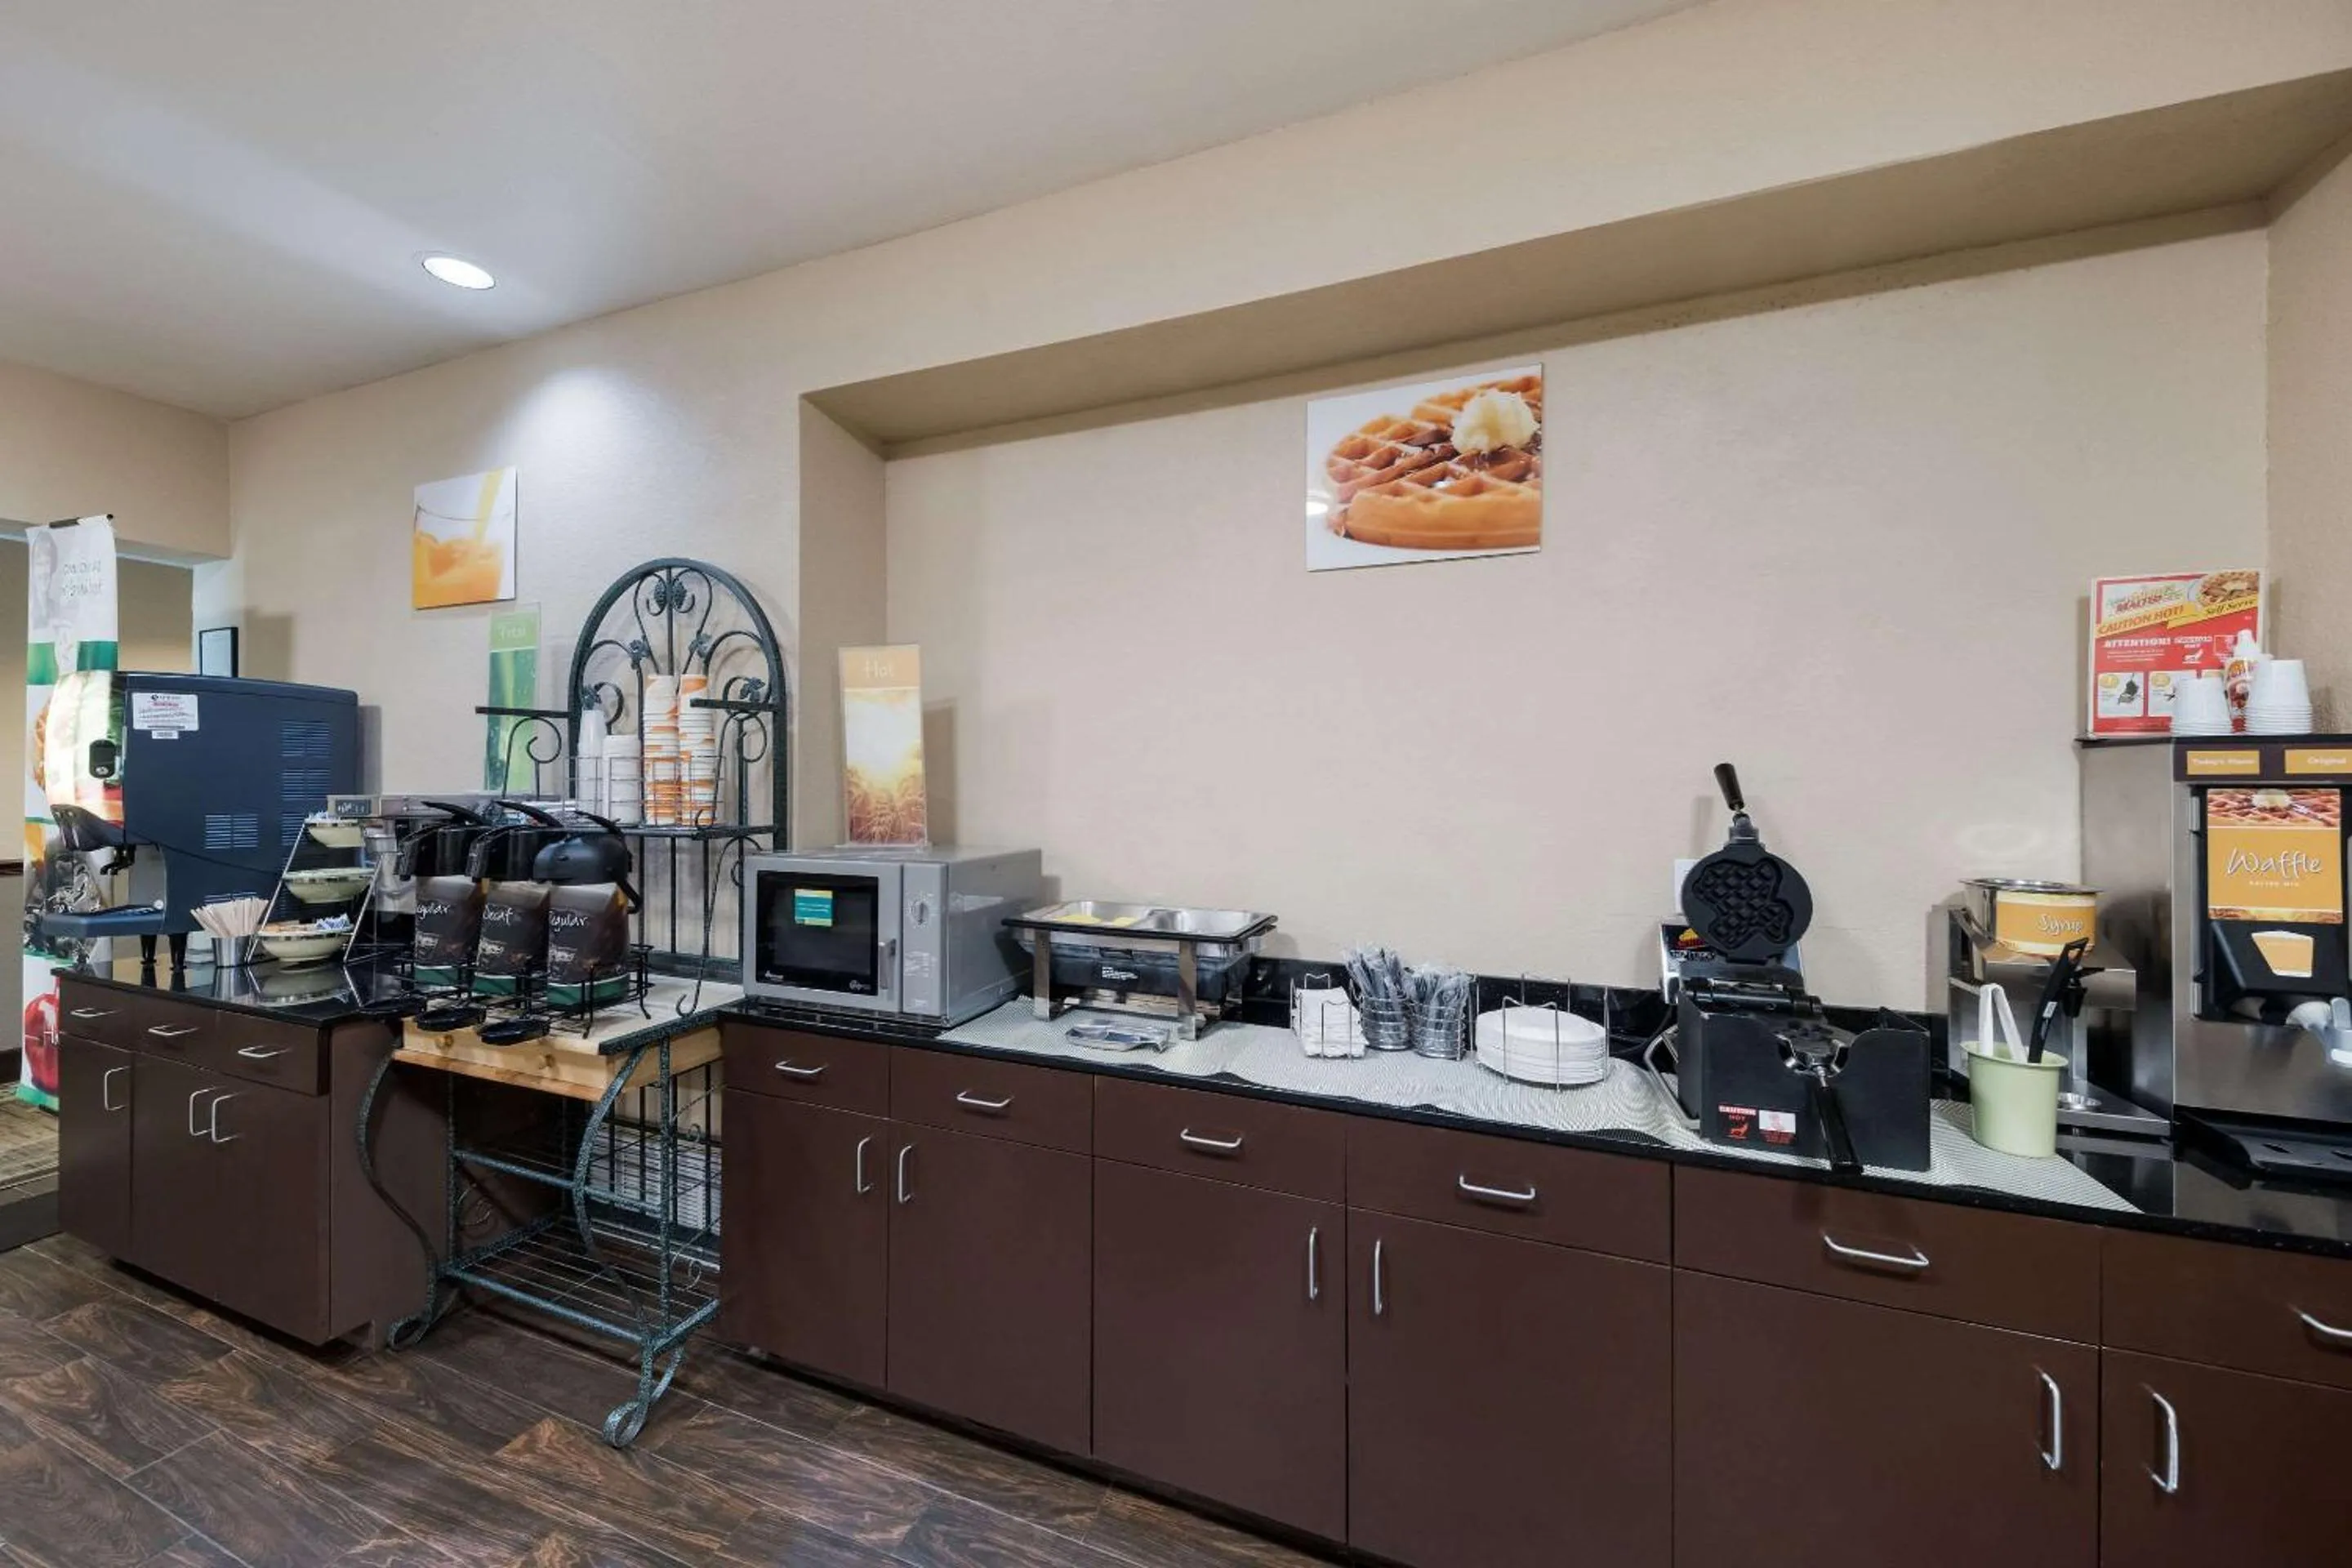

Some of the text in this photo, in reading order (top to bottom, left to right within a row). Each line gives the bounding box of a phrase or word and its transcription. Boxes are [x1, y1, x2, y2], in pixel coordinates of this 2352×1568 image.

[2097, 610, 2153, 635] CAUTION
[2104, 637, 2172, 648] ATTENTION!
[863, 659, 894, 679] Hot
[2307, 755, 2348, 767] Original
[2226, 846, 2323, 879] Waffle
[416, 902, 451, 920] egular
[2037, 913, 2083, 937] Syrup
